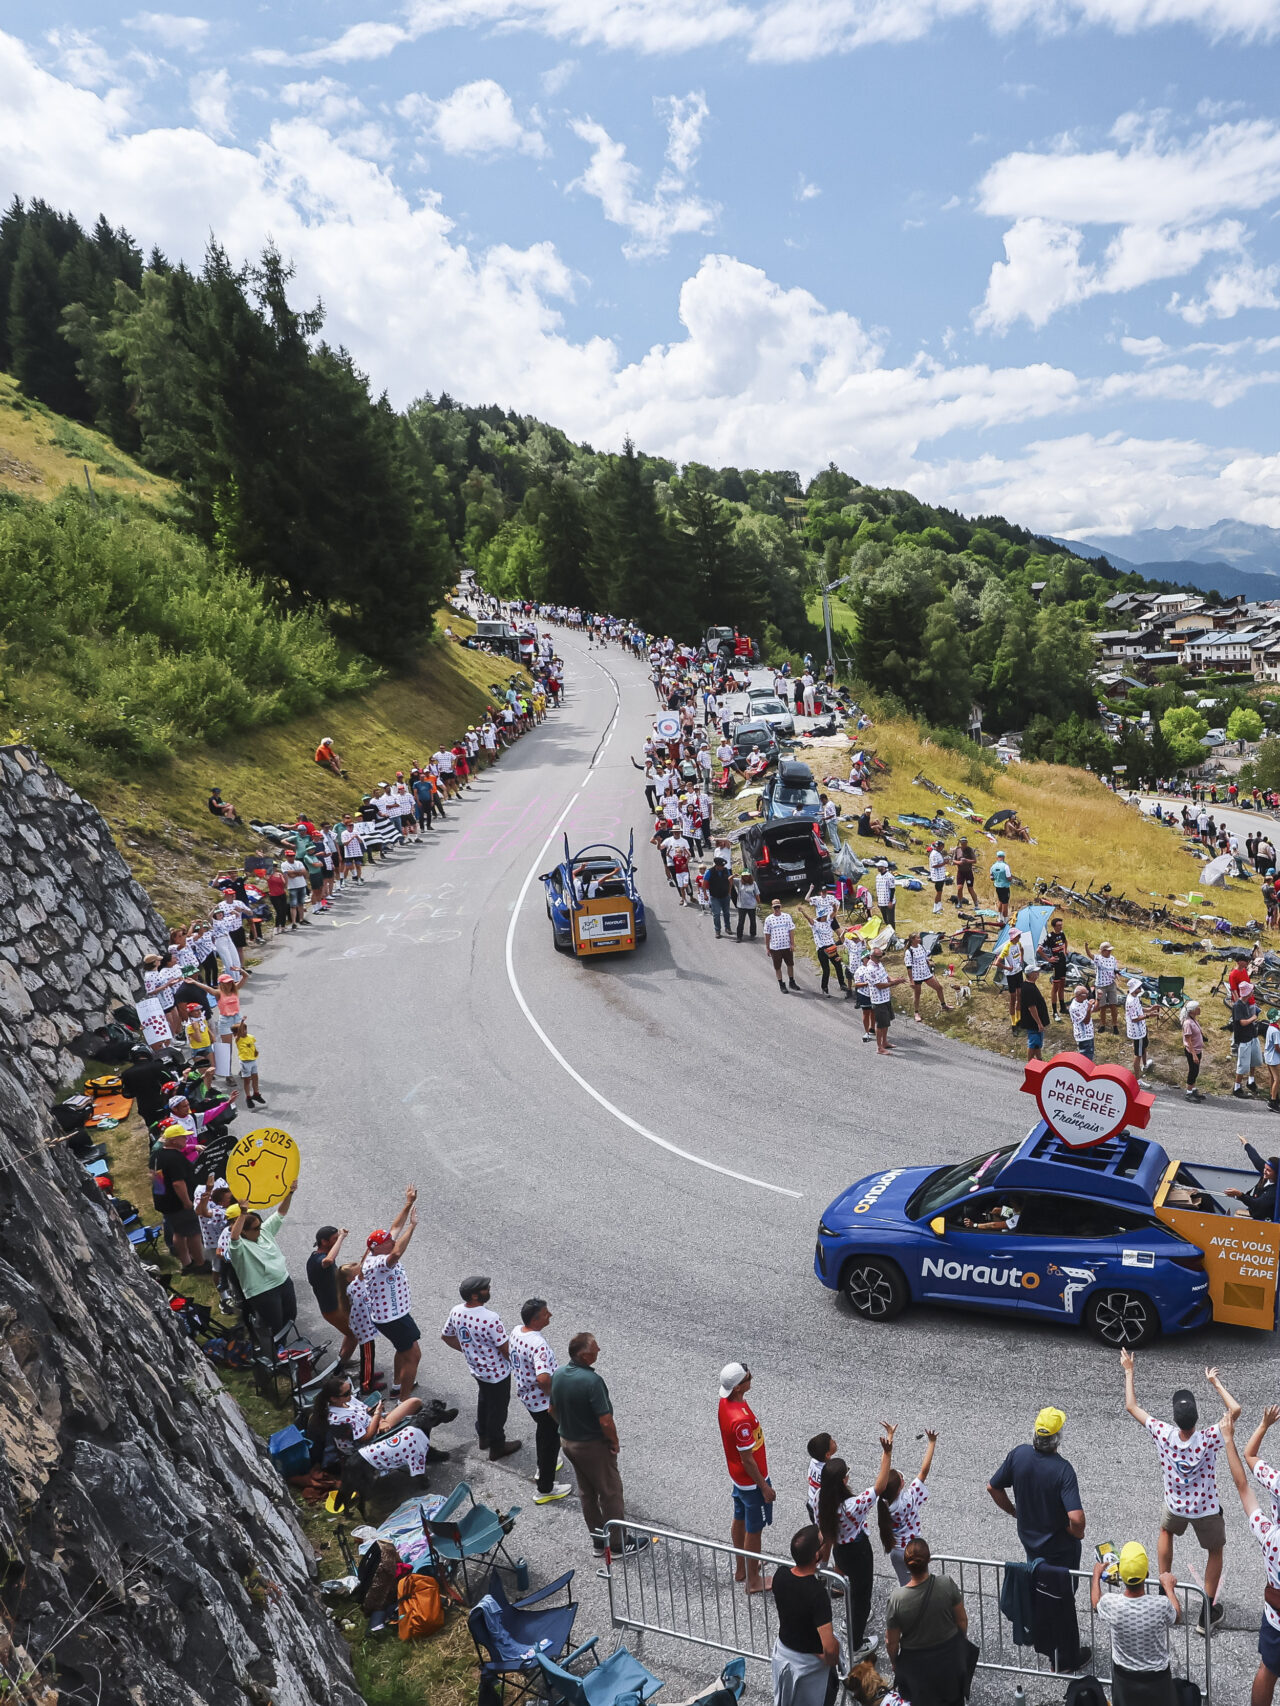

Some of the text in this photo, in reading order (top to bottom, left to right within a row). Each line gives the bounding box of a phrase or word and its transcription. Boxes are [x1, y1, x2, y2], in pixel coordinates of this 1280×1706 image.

[1055, 1078, 1114, 1105] MARQUE
[1072, 1110, 1085, 1120] des
[232, 1134, 255, 1157] TdF
[263, 1130, 293, 1149] 2025
[852, 1168, 907, 1214] Norauto
[1209, 1235, 1275, 1254] AVEC VOUS,
[1218, 1247, 1276, 1267] À CHAQUE
[921, 1256, 1040, 1290] Norauto
[1239, 1264, 1275, 1280] ÉTAPE
